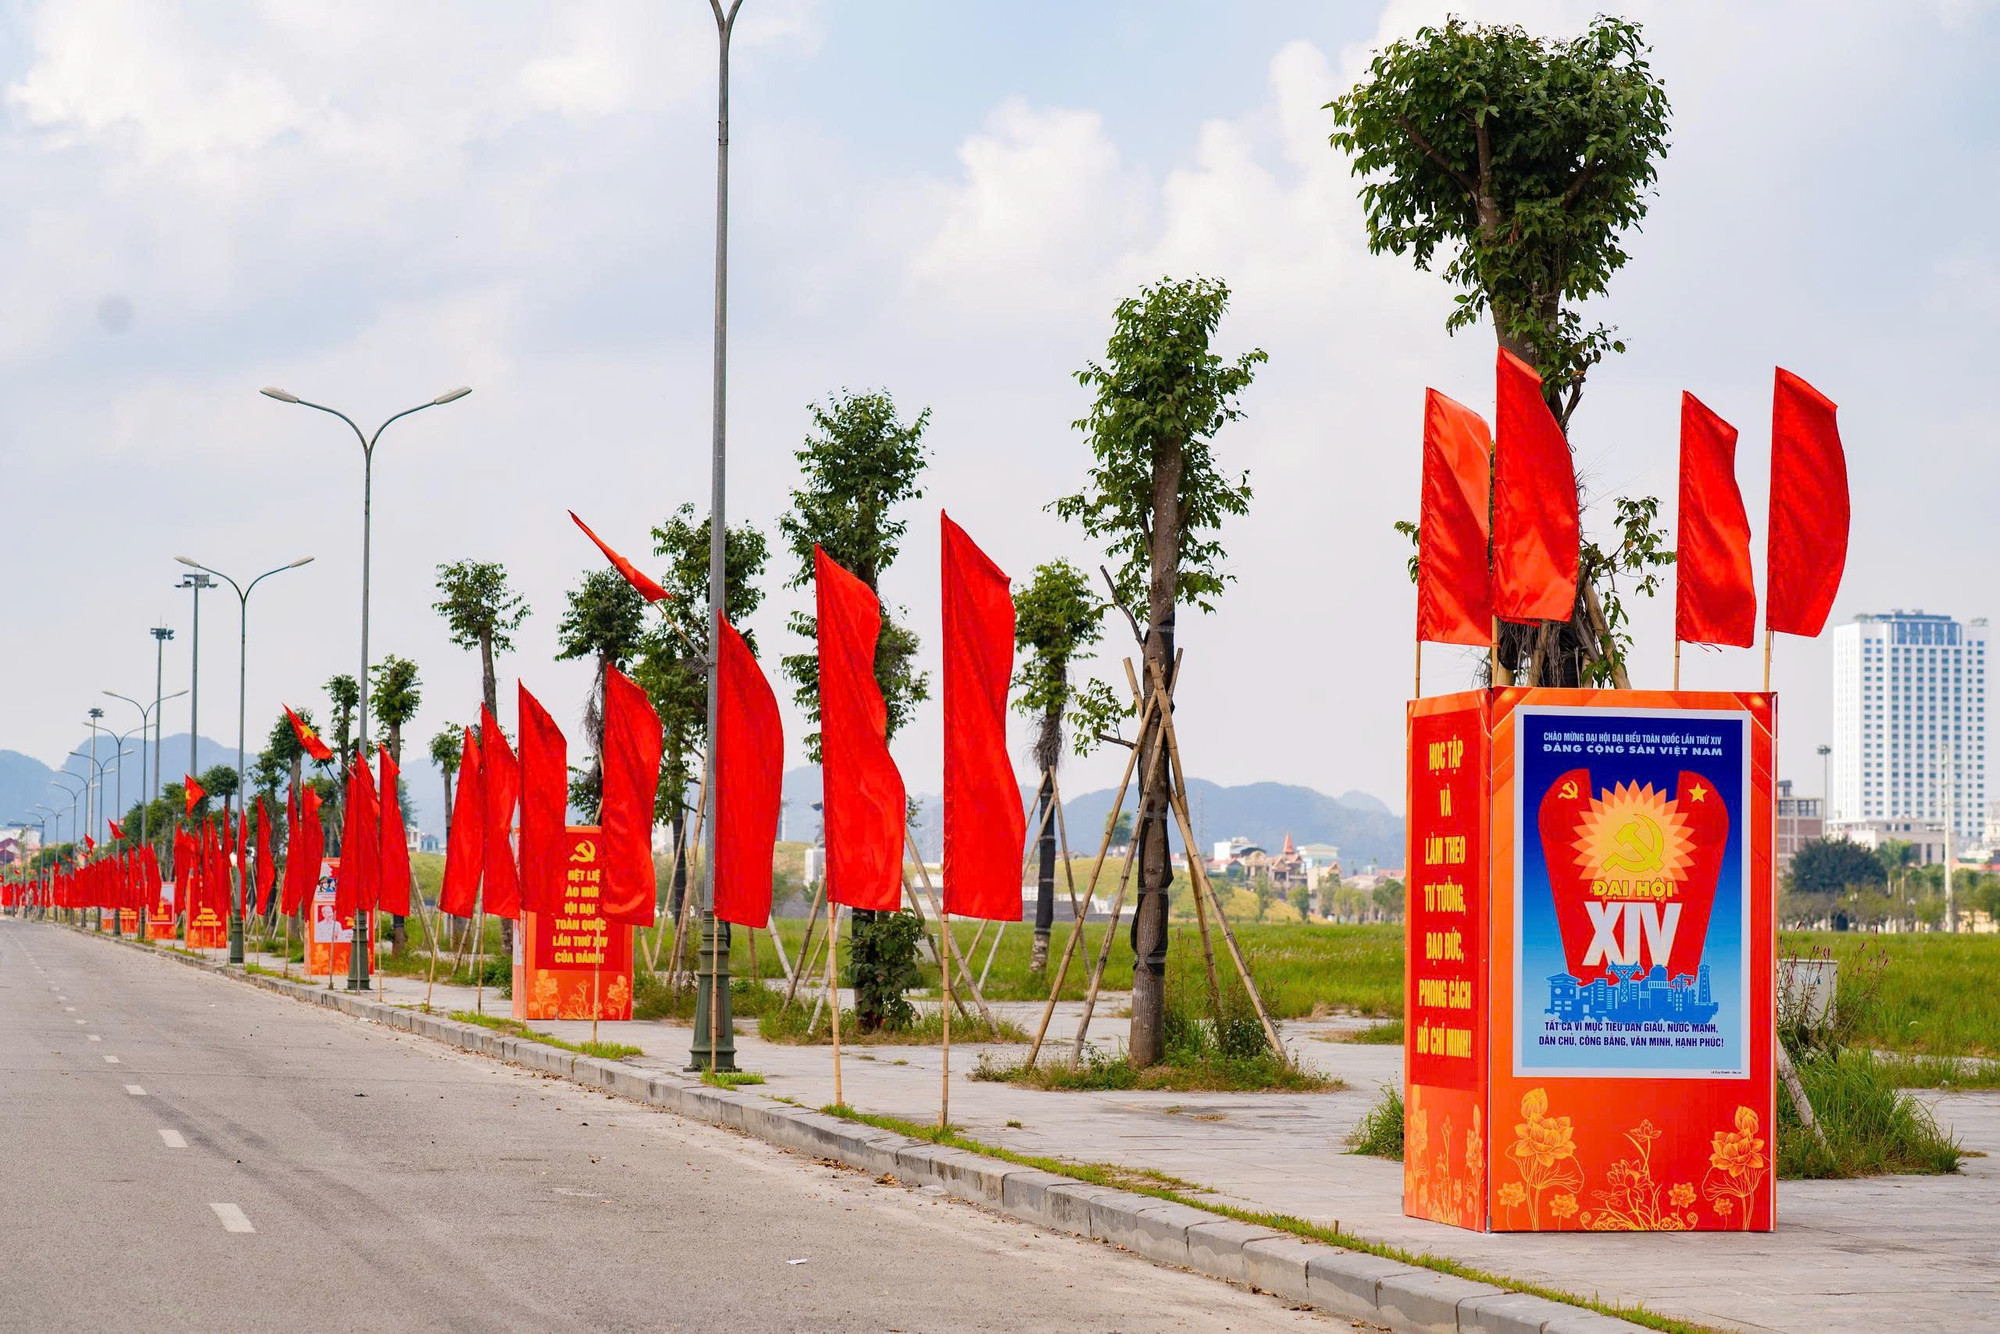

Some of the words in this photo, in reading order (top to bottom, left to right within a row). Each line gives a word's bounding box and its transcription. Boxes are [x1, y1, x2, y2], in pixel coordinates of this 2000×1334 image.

[1543, 743, 1582, 752] ĐẢNG
[1586, 745, 1624, 755] CỘNG
[1629, 744, 1655, 754] SẢN
[1659, 745, 1688, 756] VIỆT
[1692, 748, 1722, 756] NAM
[1544, 731, 1562, 741] CHÀO
[1564, 731, 1584, 742] MỪNG
[1586, 733, 1598, 744] ĐẠI
[1600, 732, 1610, 744] HỘI
[1612, 733, 1624, 744] ĐẠI
[1625, 731, 1640, 742] BIỂU
[1642, 733, 1660, 743] TOÀN
[1662, 733, 1680, 744] QUỐC
[1711, 736, 1722, 745] XIV
[1429, 742, 1445, 775] HỌC
[1448, 734, 1463, 774] TẬP
[1440, 783, 1451, 816] VÀ
[1425, 832, 1443, 865] LÀM
[1445, 836, 1466, 864] THEO
[587, 869, 600, 883] LIỆ
[1592, 880, 1629, 900] ĐẠI
[1636, 878, 1673, 901] HỘI
[1425, 882, 1435, 912] TƯ
[1437, 875, 1466, 915] TƯỞNG,
[555, 918, 580, 930] TOÀN
[1582, 901, 1683, 966] XIV
[554, 949, 573, 963] CỦA
[1426, 932, 1443, 965] ĐẠO
[1445, 927, 1464, 963] ĐỨC,
[1419, 979, 1447, 1008] PHONG
[1449, 975, 1471, 1009] CÁCH
[1417, 1017, 1428, 1054] HỒ
[1430, 1022, 1445, 1055] CHÍ
[1447, 1029, 1471, 1058] MINH!
[1585, 1022, 1602, 1033] MỤC
[1539, 1035, 1555, 1045] DÂN
[1579, 1035, 1600, 1046] CÔNG
[1649, 1037, 1673, 1047] MINH,
[1676, 1038, 1697, 1049] HẠNH
[1700, 1036, 1724, 1047] PHÚC!
